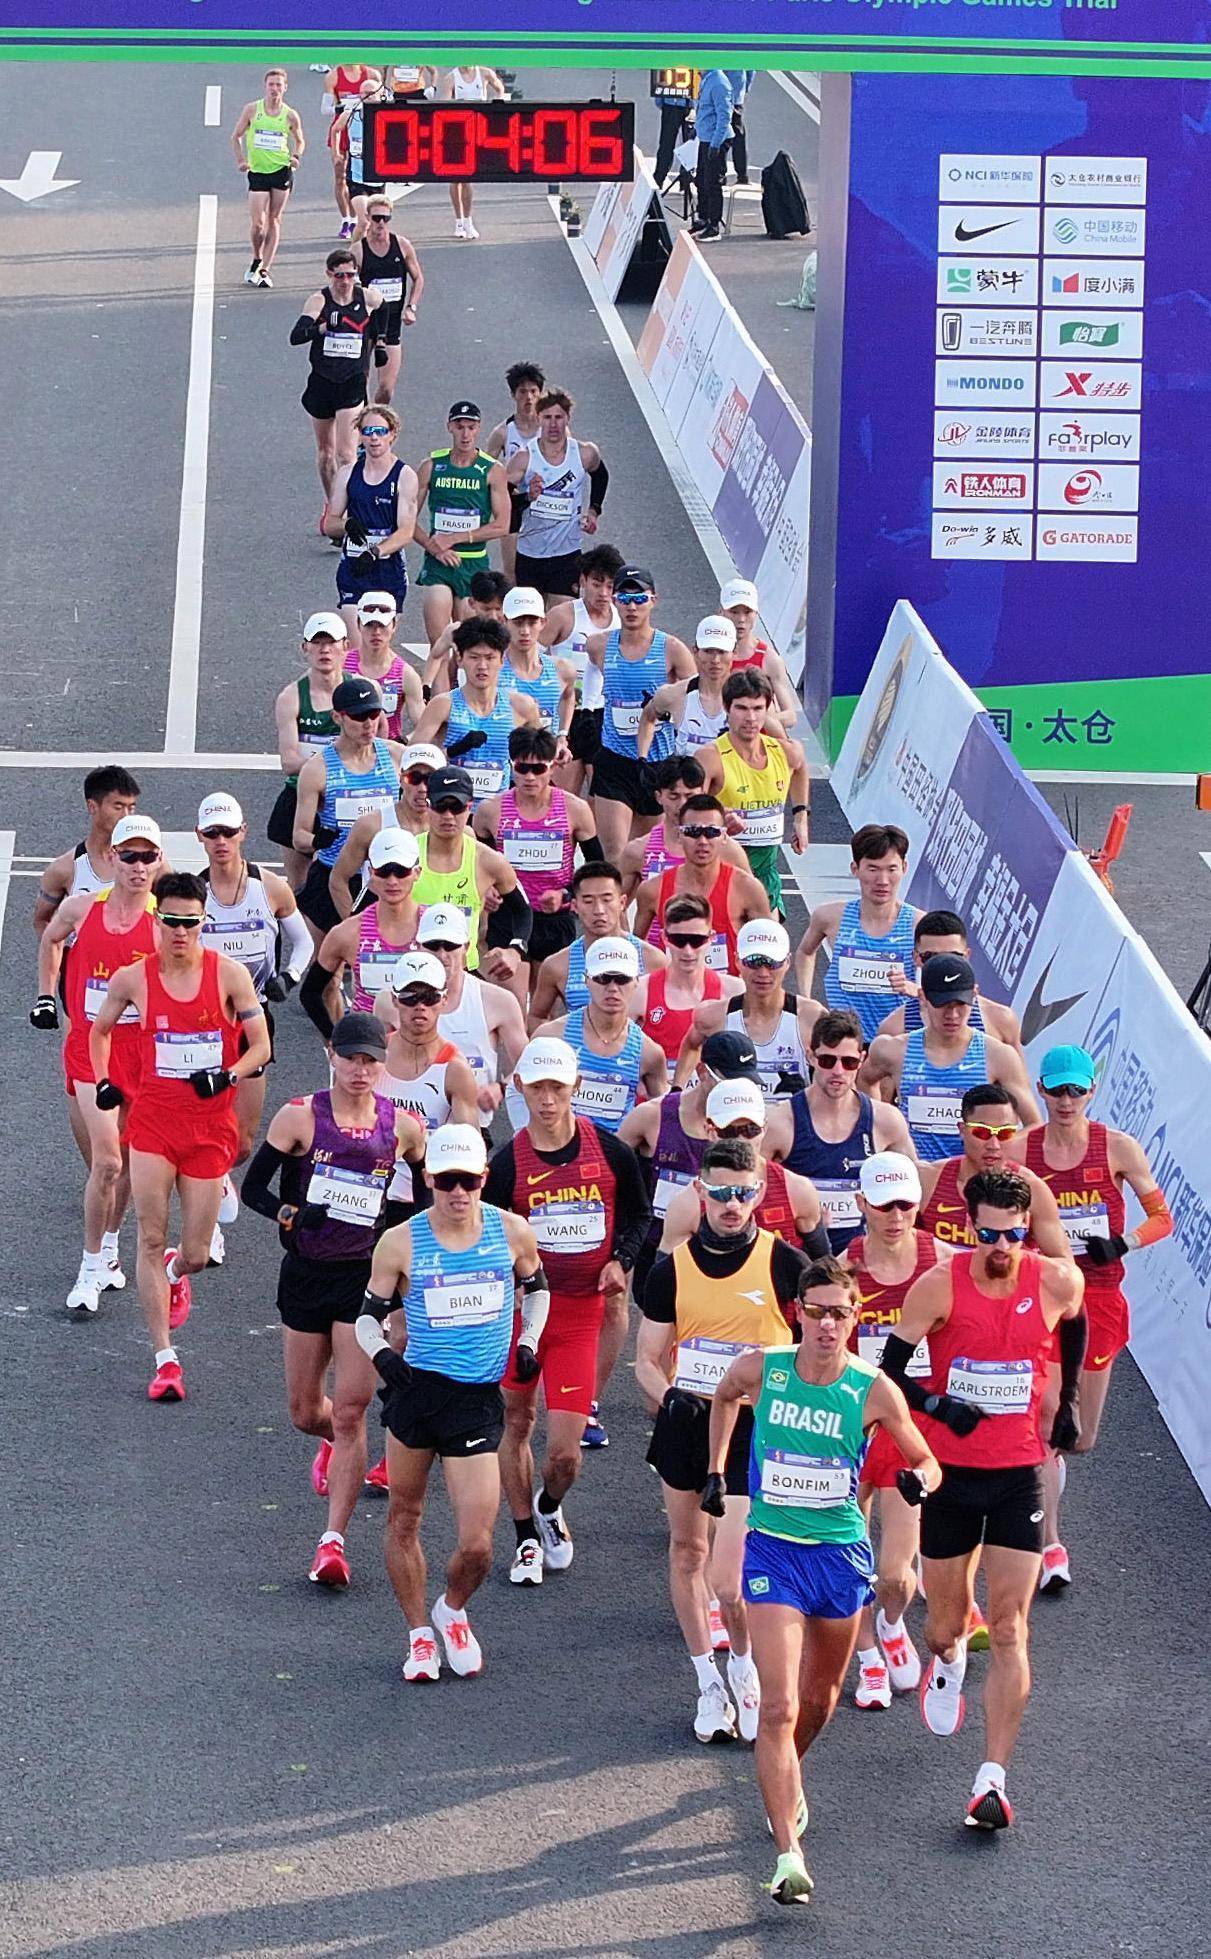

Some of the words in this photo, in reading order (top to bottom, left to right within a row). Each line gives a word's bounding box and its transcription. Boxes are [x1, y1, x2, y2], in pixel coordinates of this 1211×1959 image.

[375, 109, 623, 176] 0:04:06
[965, 170, 987, 181] NCI
[1068, 173, 1142, 185] 太仓农村商业银行
[1084, 219, 1138, 233] 中国移动
[1084, 233, 1108, 243] China
[1109, 234, 1137, 243] Mobile
[976, 269, 1024, 293] 蒙牛
[1083, 277, 1135, 293] 度小满
[969, 319, 1033, 335] 一汽奔腾
[959, 377, 1024, 391] MONDO
[975, 426, 1031, 438] 金陵体育
[435, 477, 480, 490] AUSTRALIA
[964, 489, 1021, 497] IRONMAN
[535, 500, 569, 511] DICKSON
[442, 520, 472, 529] FRASER
[980, 526, 1023, 547] 多威
[1060, 532, 1133, 544] GATORADE
[518, 849, 548, 858] ZHOU
[747, 934, 778, 944] CHINA
[223, 941, 244, 951] NIU
[598, 951, 629, 961] CHINA
[852, 967, 886, 980] ZHOU
[183, 1053, 193, 1064] LI
[533, 1056, 563, 1066] CHINA
[391, 1097, 427, 1117] UNAN
[440, 1143, 471, 1153] CHINA
[874, 1172, 910, 1183] CHINA
[322, 1189, 368, 1209] ZHANG
[528, 1184, 602, 1209] CHINA
[1057, 1189, 1102, 1207] HINA
[819, 1201, 853, 1212] WLEY
[546, 1225, 588, 1237] WANG
[935, 1220, 978, 1245] CHI
[1065, 1228, 1090, 1240] ANG
[449, 1295, 483, 1309] BIAN
[860, 1309, 902, 1325] CHI
[693, 1362, 727, 1377] STAN
[950, 1379, 1029, 1397] KARLSTROEM
[768, 1399, 844, 1440] BRASIL
[771, 1473, 830, 1492] BONFIM
